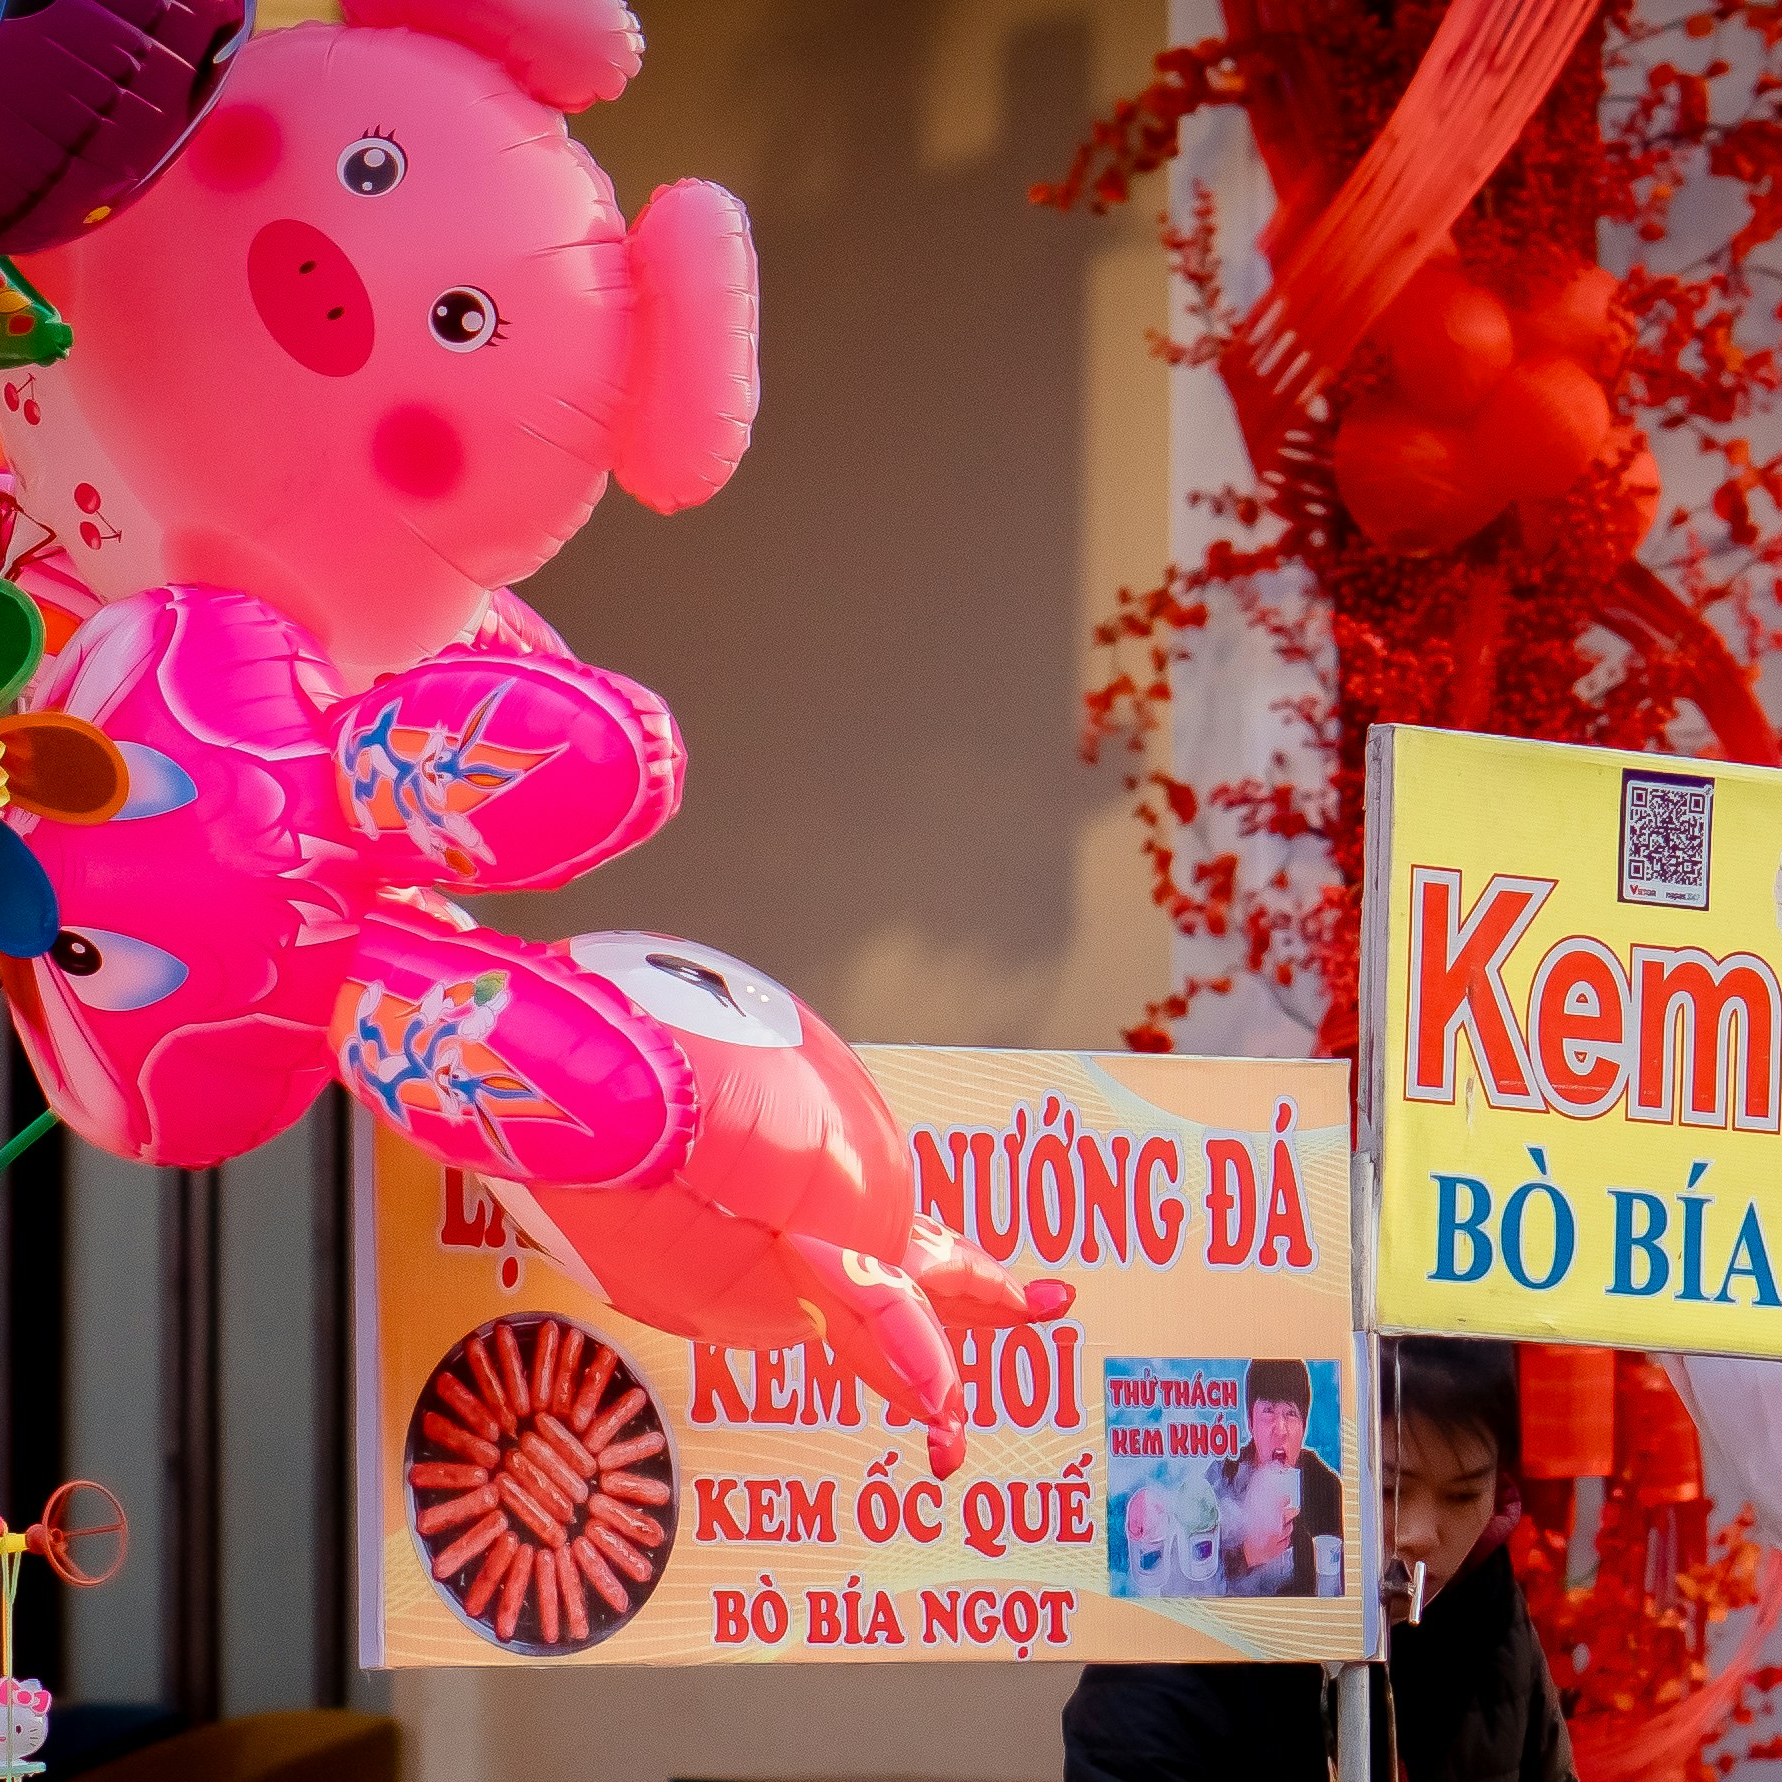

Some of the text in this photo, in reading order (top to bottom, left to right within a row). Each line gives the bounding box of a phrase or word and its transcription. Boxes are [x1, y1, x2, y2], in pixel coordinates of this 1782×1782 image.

[915, 1096, 1314, 1264] NƯỚNG ĐÁ
[1427, 1146, 1577, 1291] BÒ
[1110, 1368, 1238, 1408] THỬ THÁCH
[1112, 1412, 1238, 1456] KEM KHÓI
[695, 1452, 1094, 1556] KEM ỐC QUẾ
[714, 1574, 1076, 1660] BÒ BÍA NGỌT
